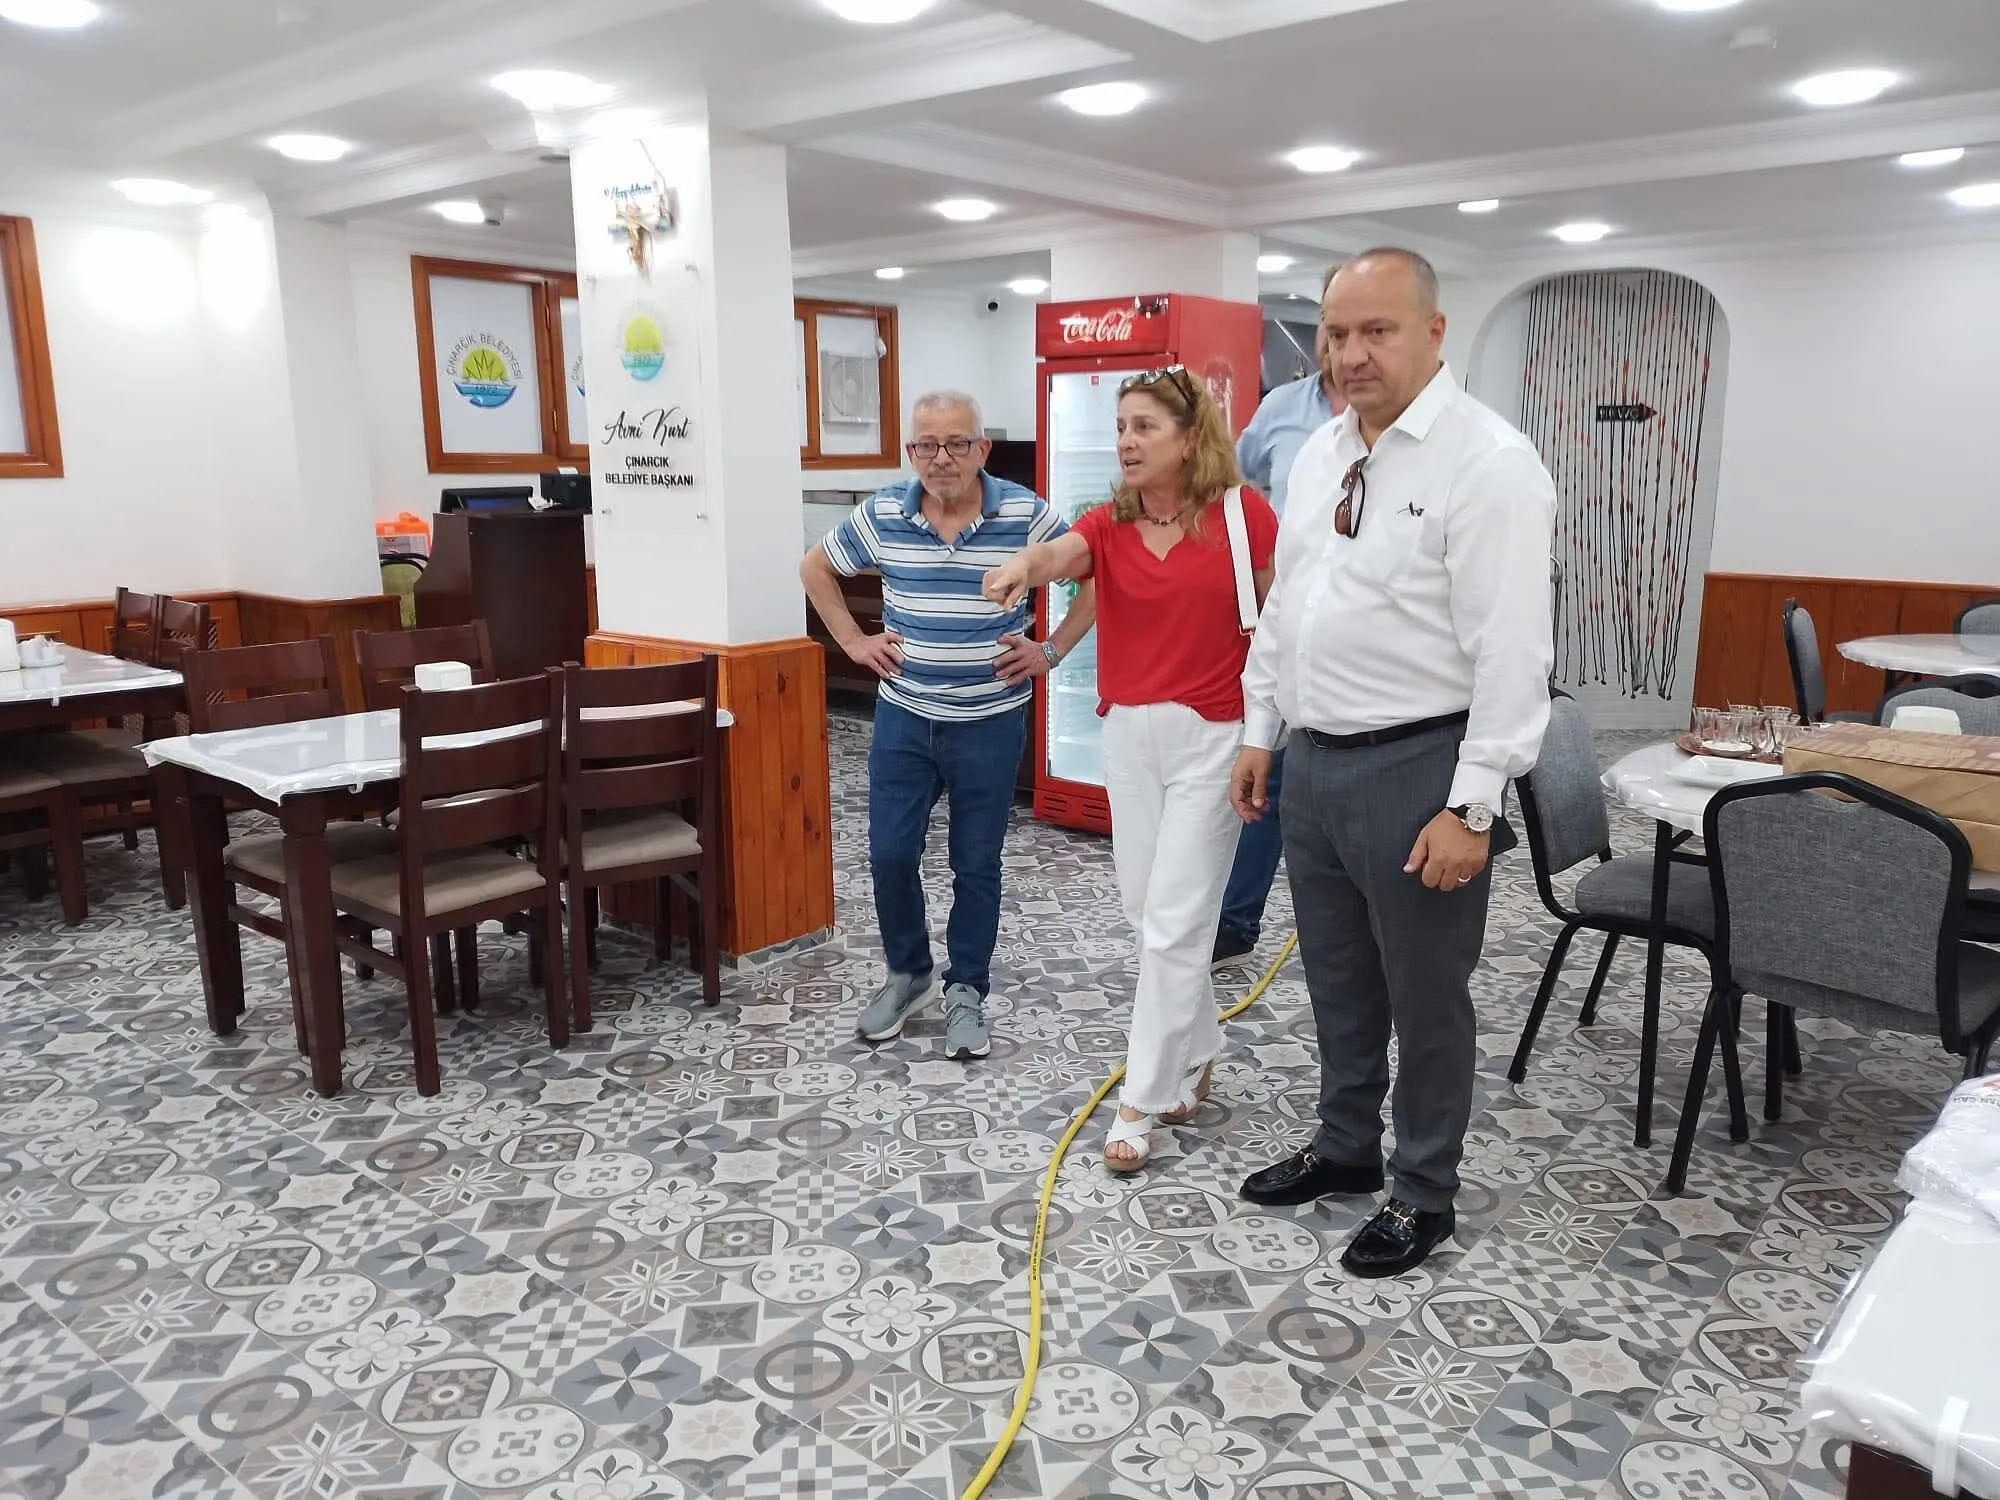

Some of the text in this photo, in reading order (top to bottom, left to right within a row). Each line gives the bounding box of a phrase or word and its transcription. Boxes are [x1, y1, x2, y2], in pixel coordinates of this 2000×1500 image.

[602, 407, 691, 446] Avni Kurt
[625, 456, 670, 469] ÇINARCIK
[605, 470, 694, 489] BELEDİYE BAŞKANI
